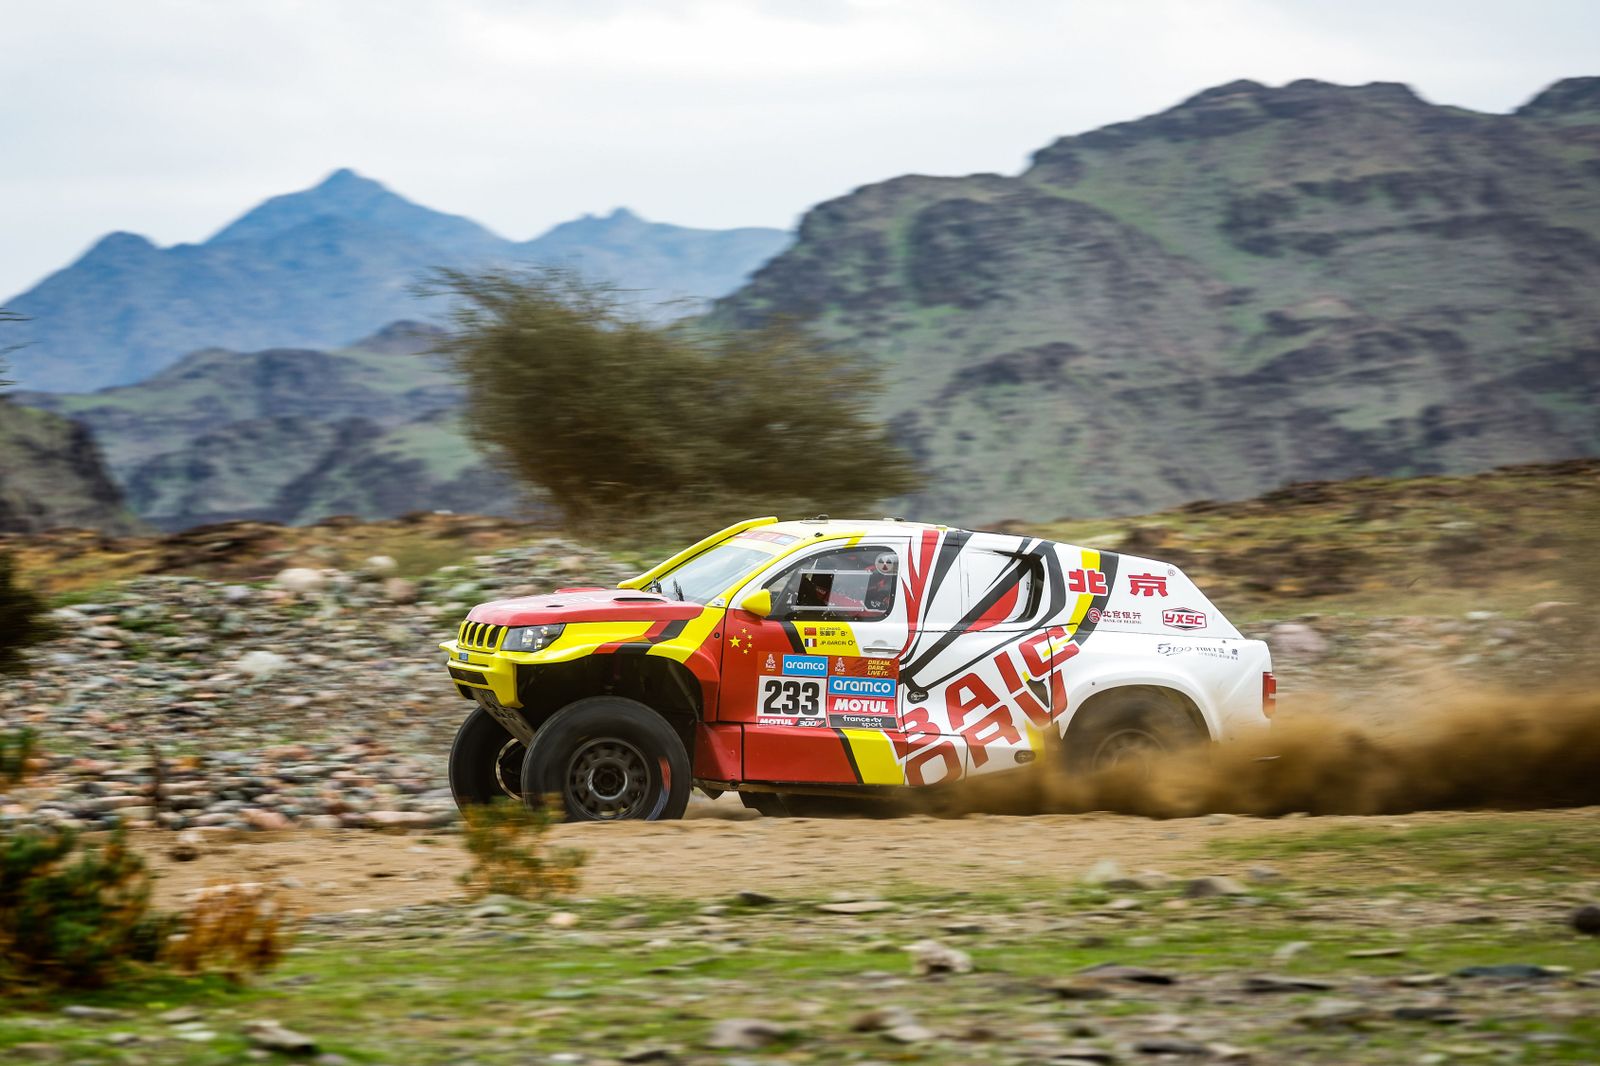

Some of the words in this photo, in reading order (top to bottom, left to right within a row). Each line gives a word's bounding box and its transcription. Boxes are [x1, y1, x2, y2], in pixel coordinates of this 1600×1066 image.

[1068, 569, 1169, 598] 北京
[1102, 610, 1142, 619] 北京银行
[1164, 614, 1204, 625] YXSC
[785, 661, 825, 671] aramco
[833, 680, 891, 693] aramco
[891, 626, 1080, 760] BAIC
[763, 680, 820, 716] 233
[833, 698, 889, 713] MOTUL
[759, 718, 794, 726] MOTUL
